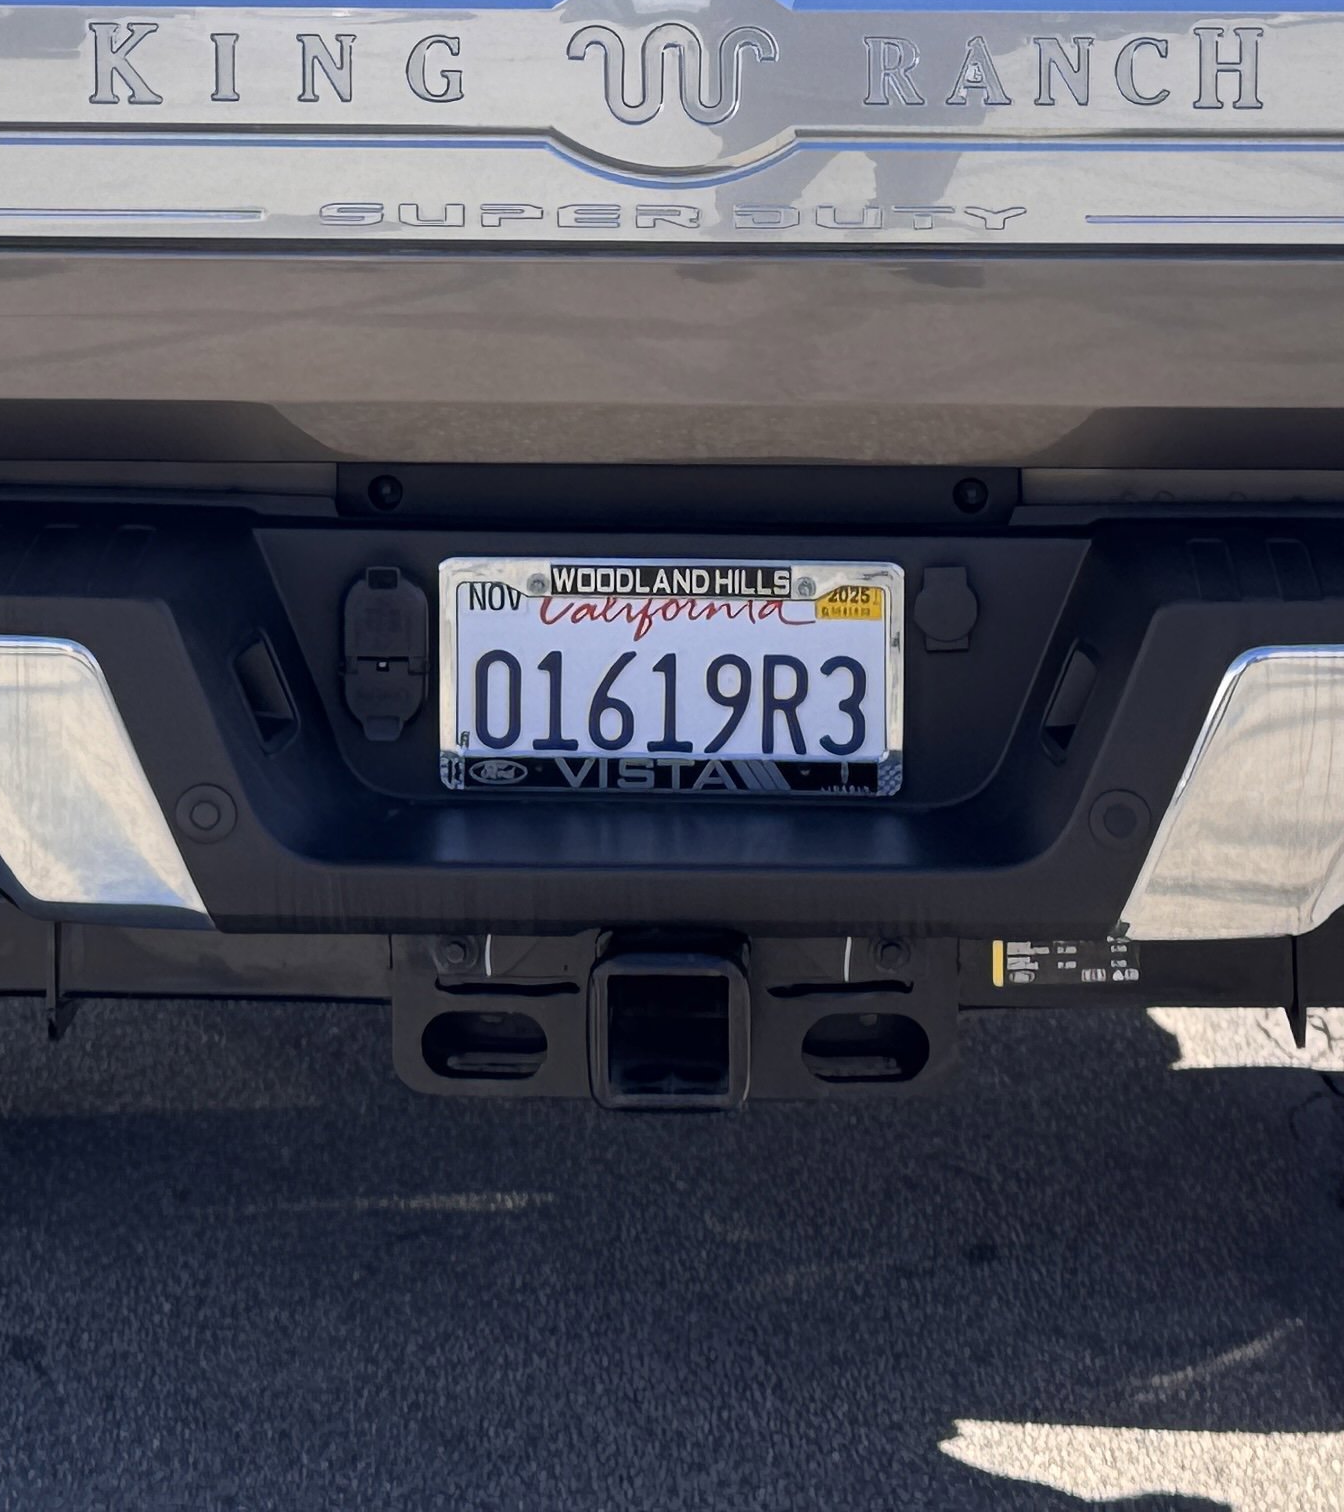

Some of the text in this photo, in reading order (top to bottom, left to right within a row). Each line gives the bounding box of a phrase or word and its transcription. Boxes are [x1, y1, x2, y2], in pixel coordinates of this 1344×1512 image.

[88, 21, 1264, 110] KING RANCH
[319, 202, 1027, 230] SUPER DUTY
[552, 567, 791, 596] WOODLAND HILLS
[828, 585, 871, 604] 2025
[468, 583, 522, 611] NOV
[540, 596, 816, 641] California
[474, 649, 868, 755] 01619R3
[556, 758, 732, 790] VISTA
